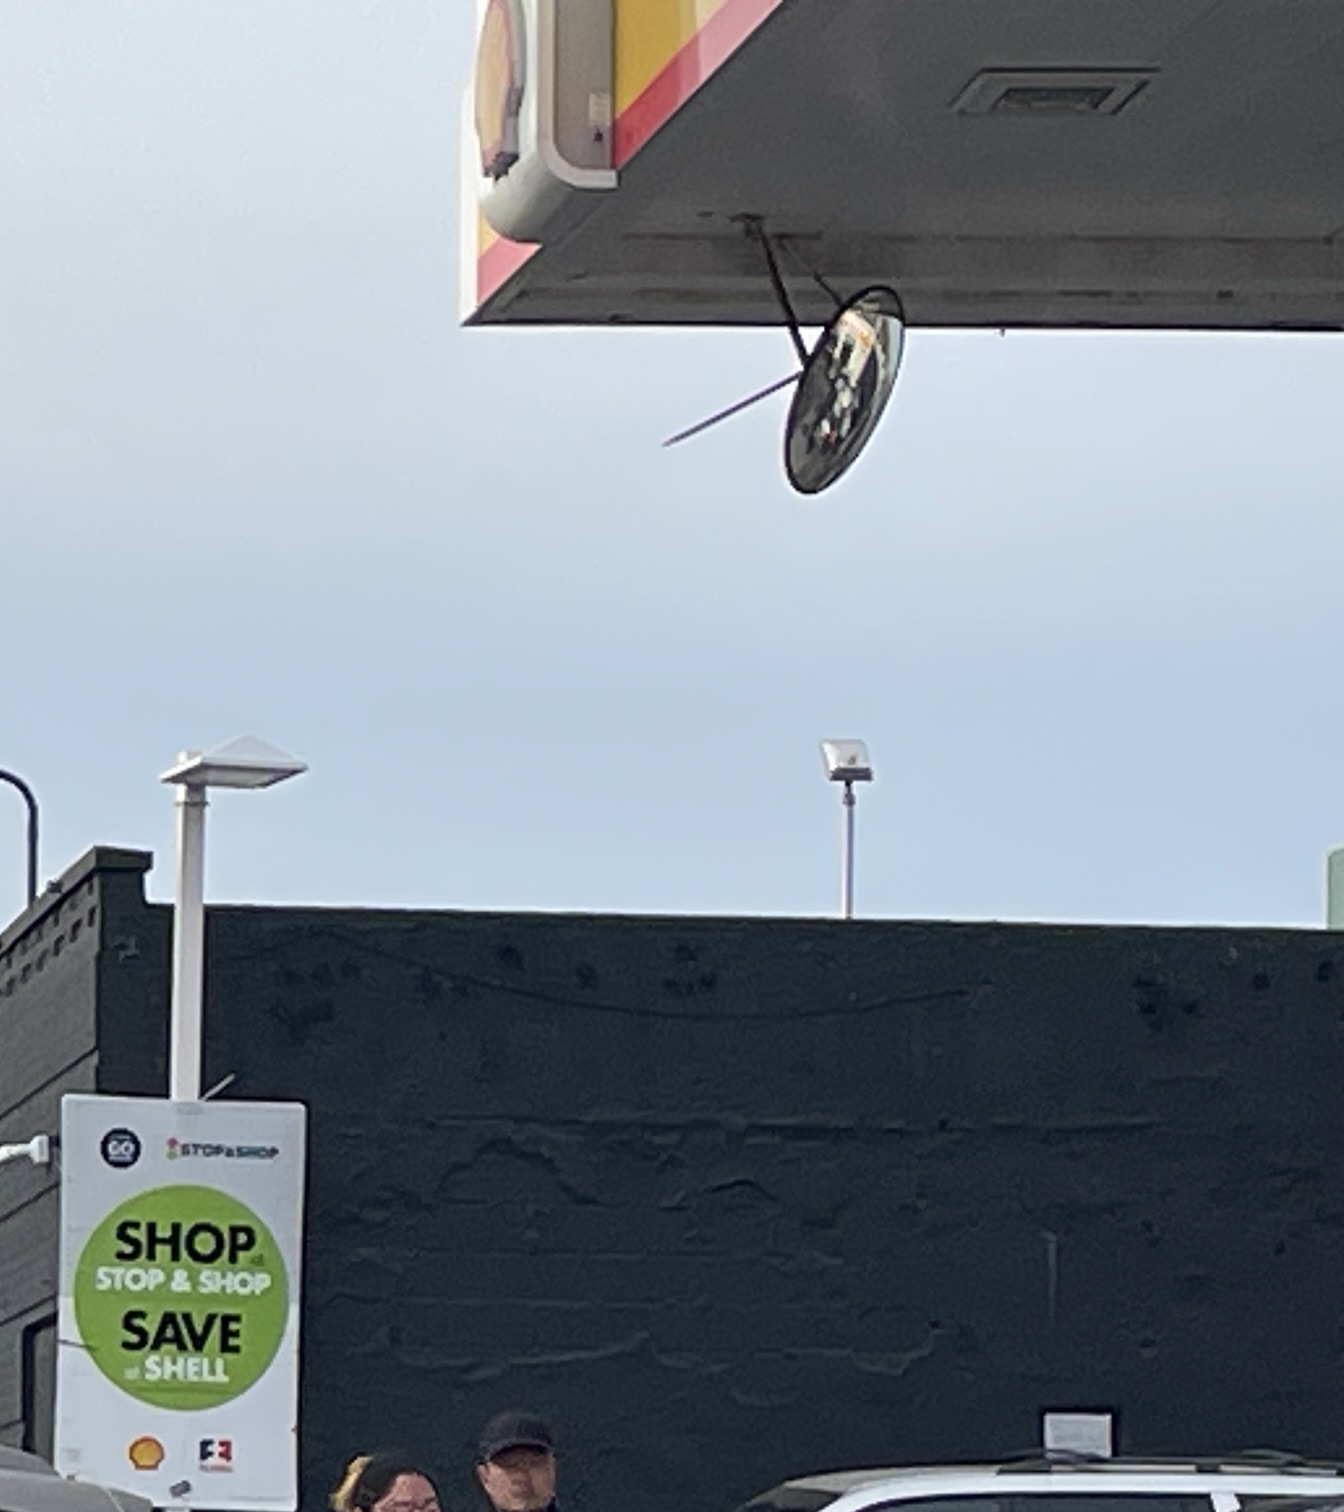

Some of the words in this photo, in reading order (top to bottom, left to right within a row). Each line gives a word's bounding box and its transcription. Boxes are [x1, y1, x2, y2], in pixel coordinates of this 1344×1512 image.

[115, 1220, 257, 1264] SHOP
[95, 1267, 165, 1292] STOP
[170, 1271, 191, 1293] &
[197, 1271, 272, 1296] SHOP
[120, 1309, 243, 1355] SAVE
[144, 1354, 230, 1383] SHELL
